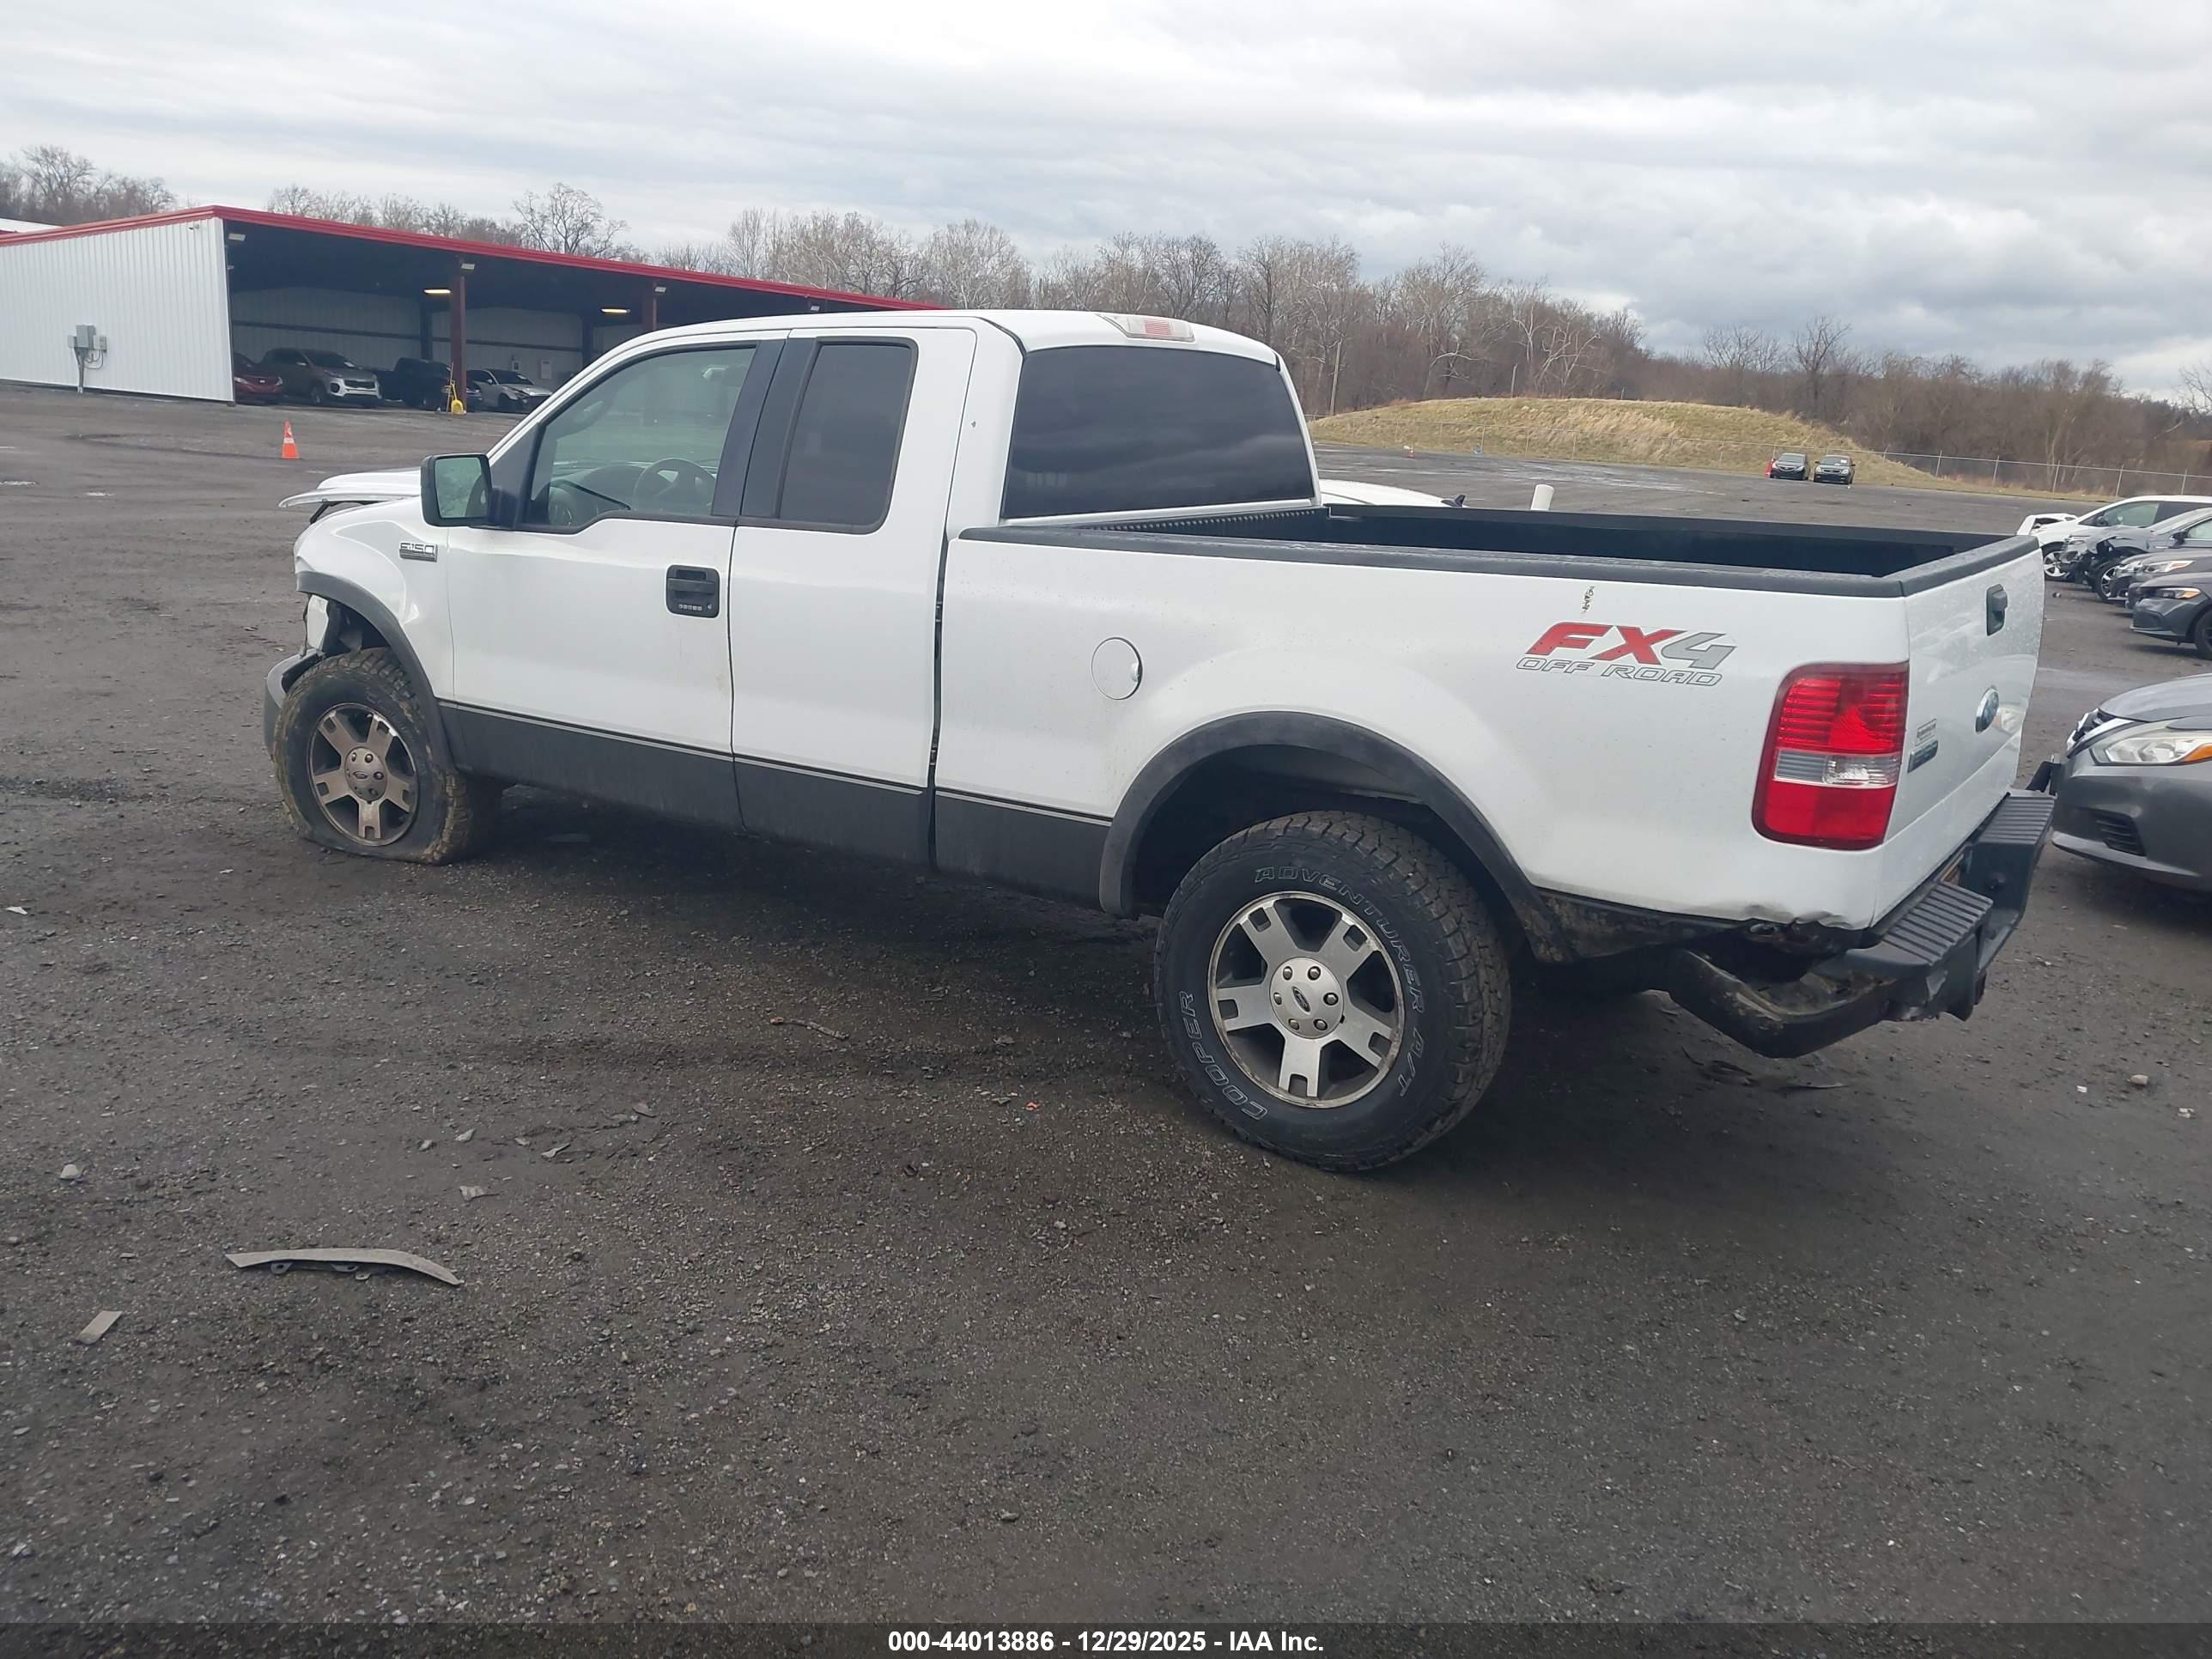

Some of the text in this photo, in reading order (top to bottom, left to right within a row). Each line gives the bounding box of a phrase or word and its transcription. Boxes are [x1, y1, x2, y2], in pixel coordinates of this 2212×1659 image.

[1516, 657, 1723, 687] OFF ROAD
[1525, 621, 1738, 670] FX4
[1254, 865, 1426, 1014] ADVENTURER
[1178, 989, 1268, 1121] COOPER
